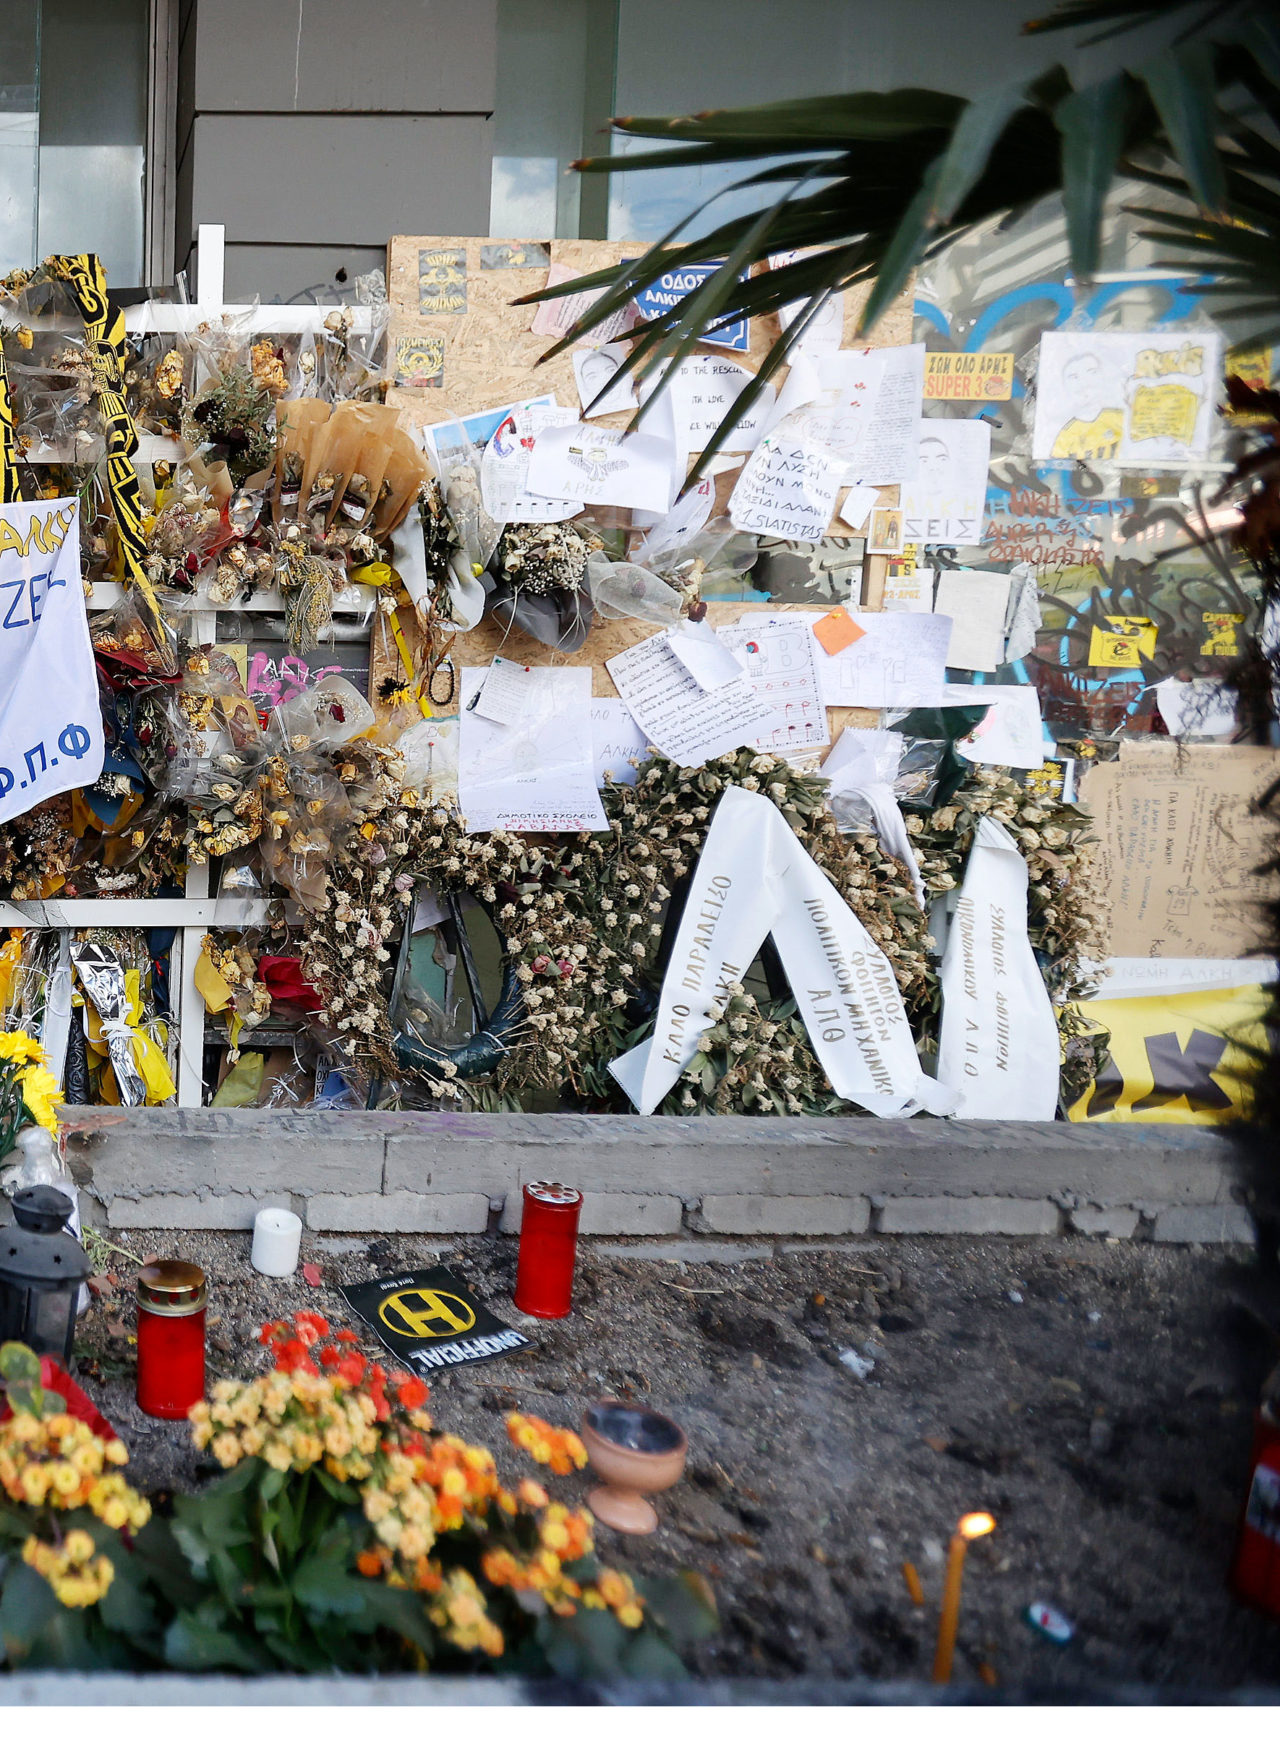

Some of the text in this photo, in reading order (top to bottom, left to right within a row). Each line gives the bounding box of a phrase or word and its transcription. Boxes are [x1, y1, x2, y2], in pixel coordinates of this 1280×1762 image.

[695, 366, 710, 375] THE
[955, 355, 975, 374] ΟΛΟ
[978, 355, 1008, 374] ΑΡΗΣ
[927, 375, 983, 397] SUPER 3
[600, 743, 639, 760] ΑΛΚΗ
[682, 874, 732, 992] ΠΑΡΑΔΕΙΣΟ
[410, 1329, 529, 1367] UNOFFICIAL
